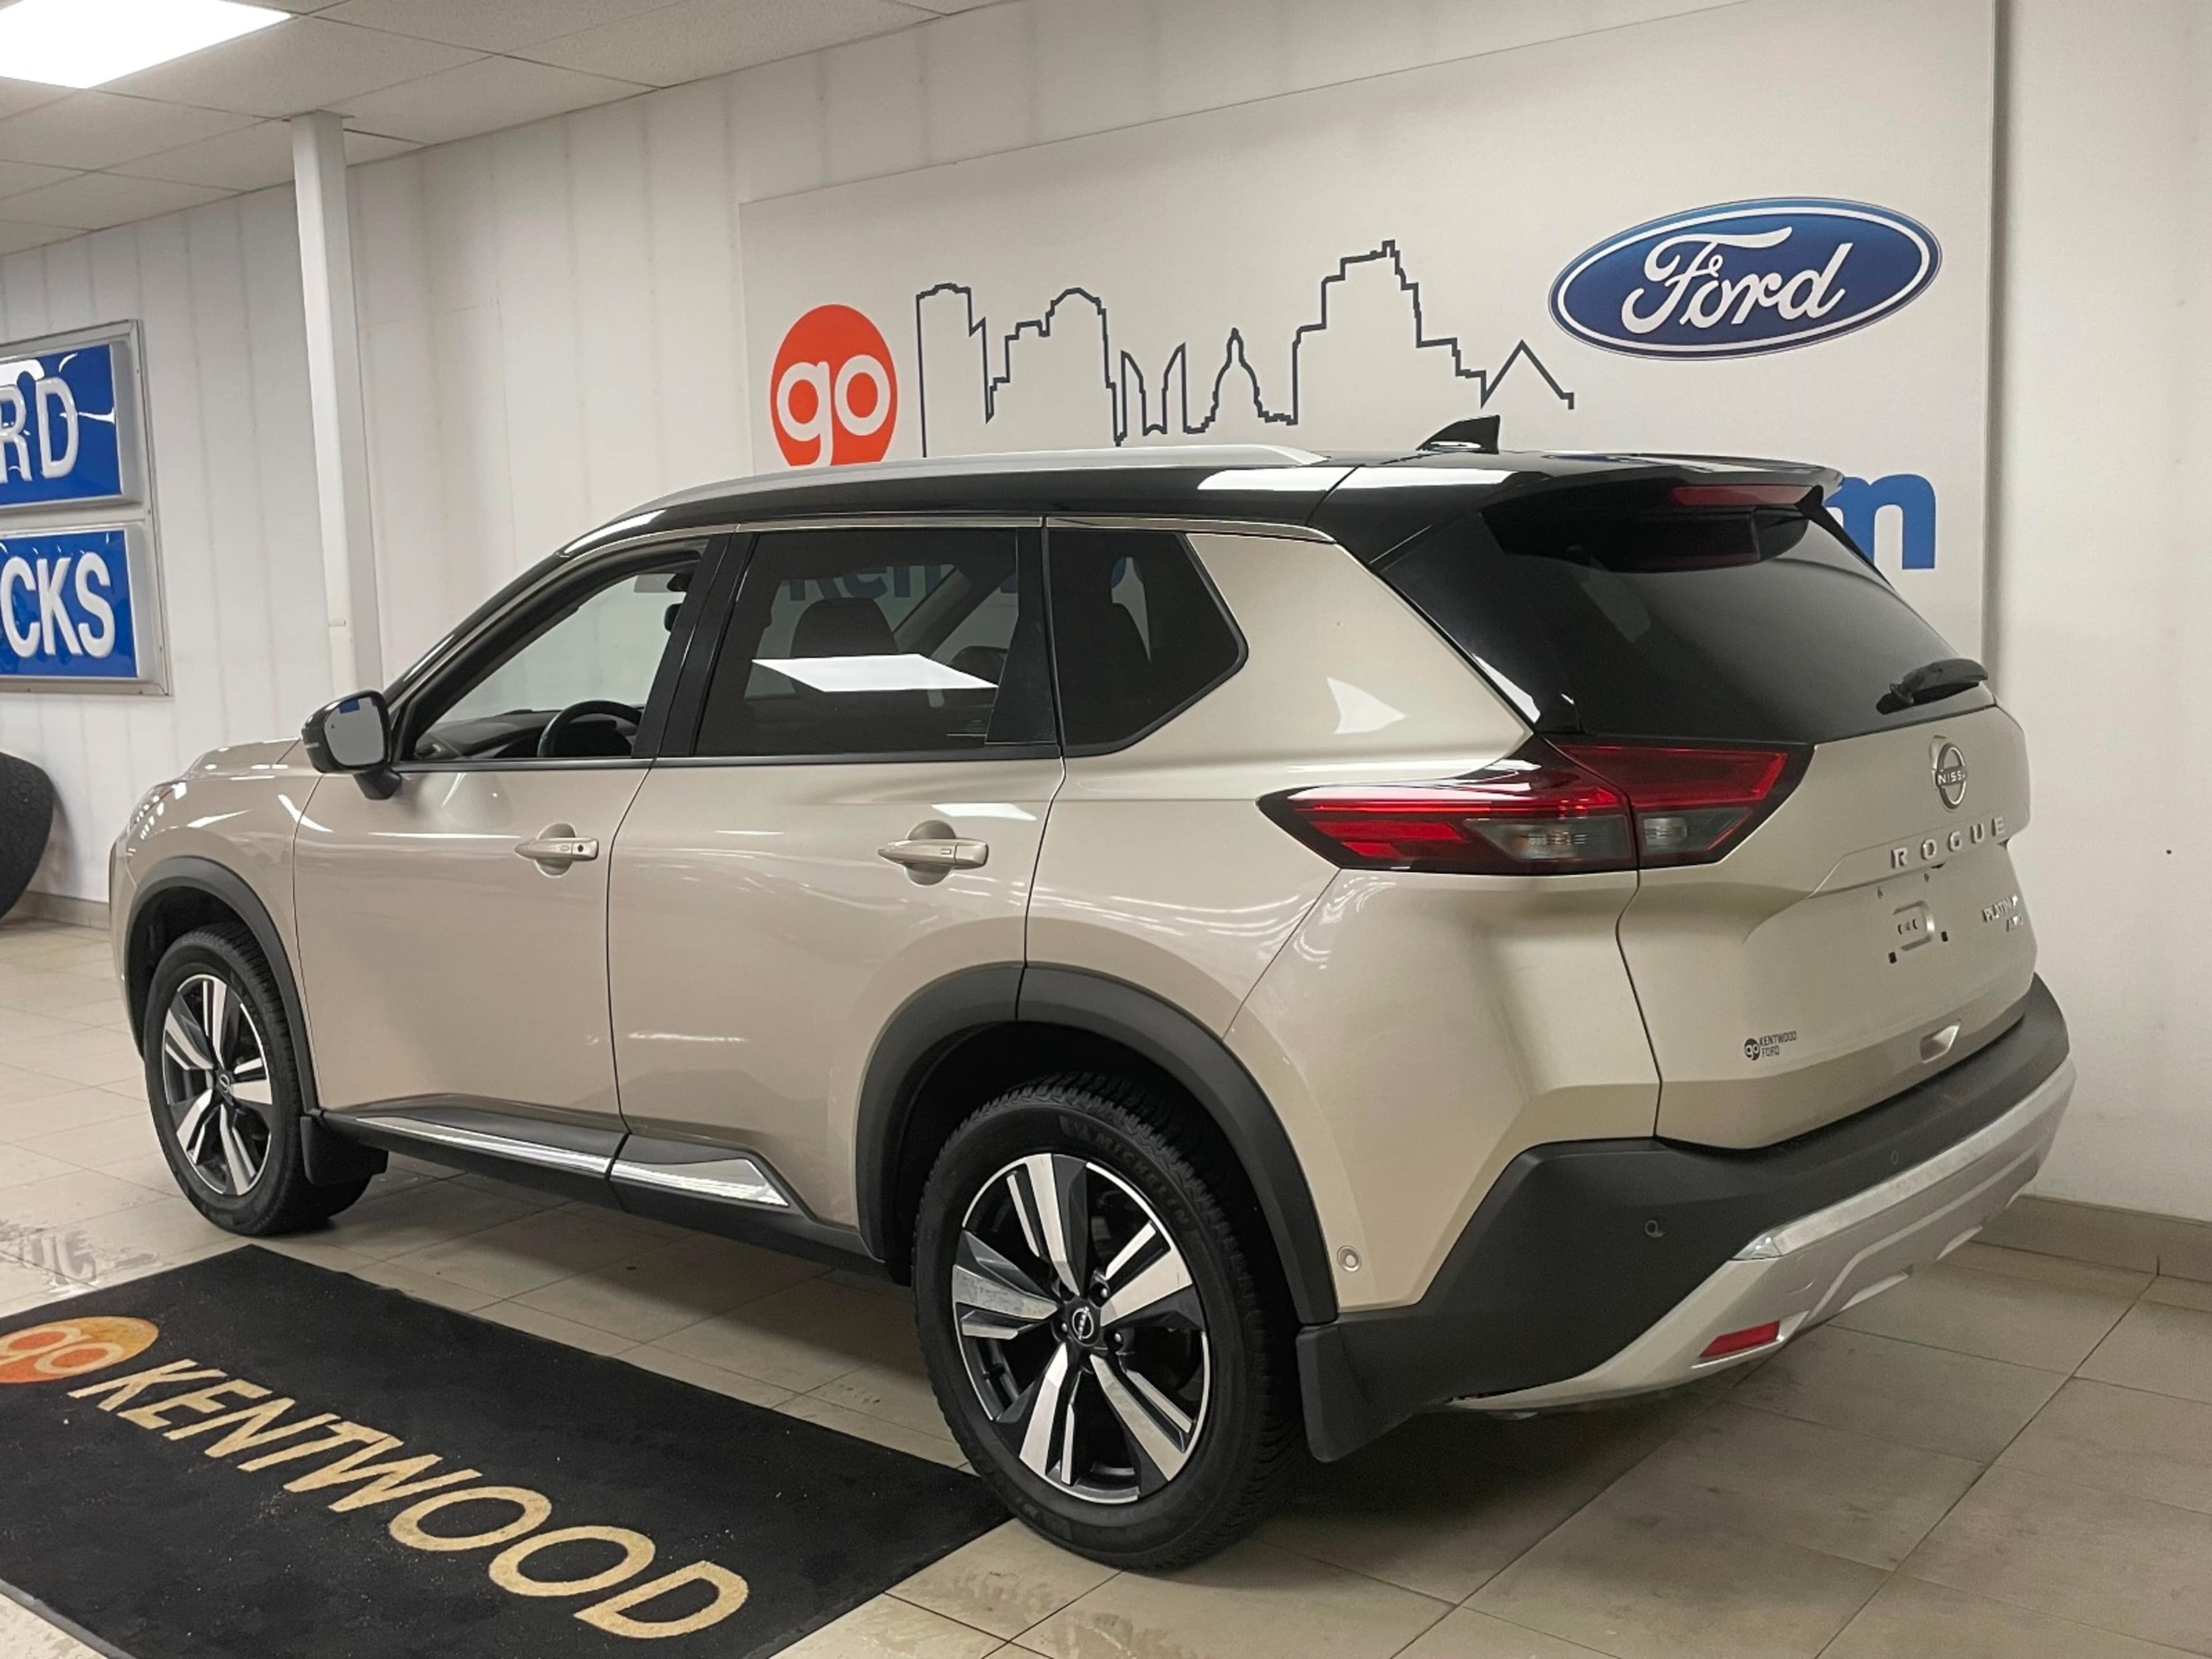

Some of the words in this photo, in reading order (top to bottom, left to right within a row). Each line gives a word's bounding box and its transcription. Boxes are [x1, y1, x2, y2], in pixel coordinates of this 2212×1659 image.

[1621, 226, 1853, 334] Ford
[777, 353, 891, 465] go
[1891, 816, 2006, 869] ROGUE
[1759, 1031, 1797, 1046] KENTWOOD
[1762, 1046, 1780, 1057] FORD
[67, 1358, 749, 1638] KENTWOOD
